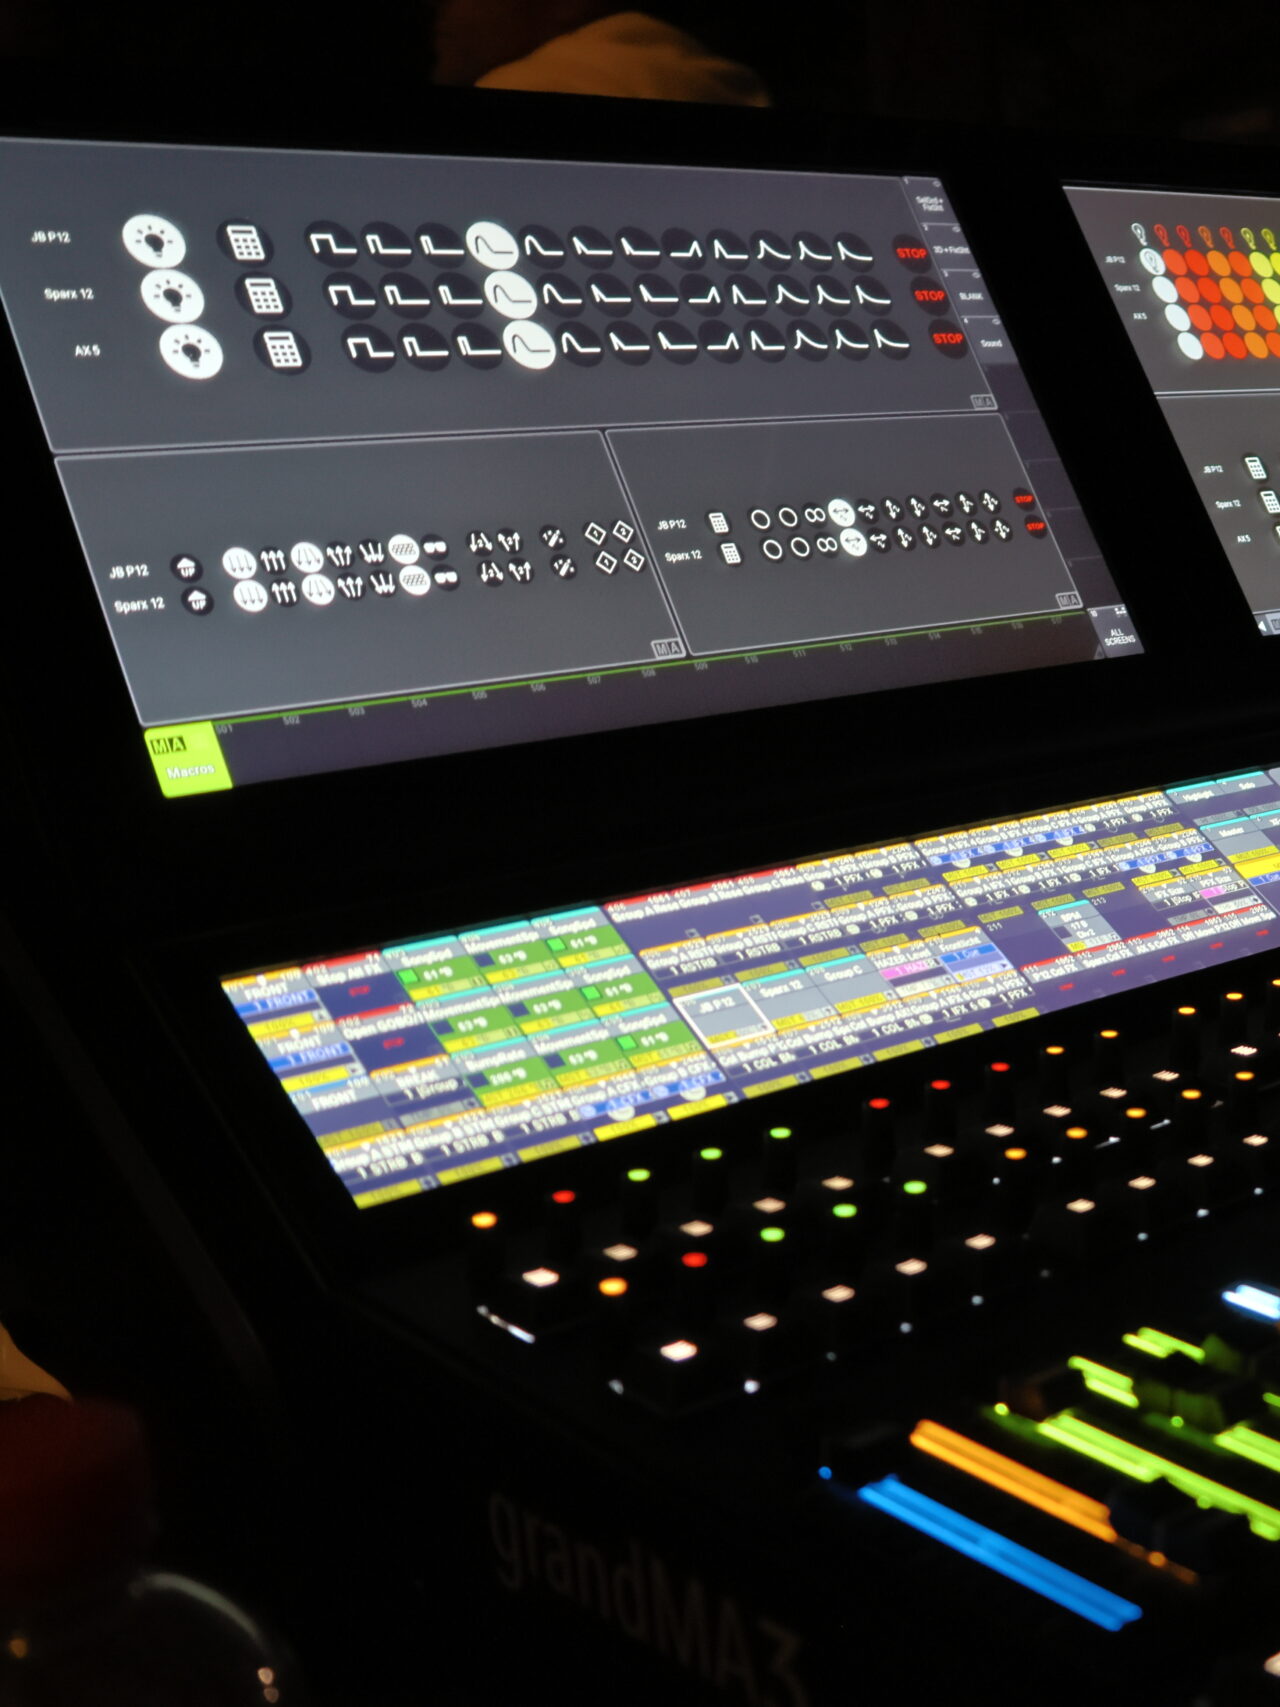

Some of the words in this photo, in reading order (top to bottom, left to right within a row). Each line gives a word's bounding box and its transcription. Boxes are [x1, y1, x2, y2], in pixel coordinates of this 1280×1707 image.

[896, 248, 928, 259] STOP
[44, 287, 78, 302] Sparx
[79, 287, 94, 300] 12
[914, 290, 945, 301] STOP
[932, 333, 963, 344] STOP
[664, 551, 690, 563] Sparx
[691, 549, 702, 560] 12
[114, 600, 148, 615] Sparx
[150, 596, 165, 609] 12
[1104, 634, 1136, 647] SCREENS
[1110, 628, 1125, 639] ALL
[282, 714, 301, 726] 502
[348, 706, 366, 717] 503
[411, 697, 428, 709] 504
[150, 736, 187, 755] MA
[166, 763, 216, 779] Macros
[1077, 814, 1101, 824] Group
[1027, 824, 1052, 834] Group
[861, 858, 891, 870] Group
[1061, 863, 1087, 873] Group
[803, 869, 833, 882] Group
[1010, 874, 1036, 885] Group
[742, 882, 773, 895] Group
[677, 894, 712, 909] Group
[897, 900, 926, 912] Group
[611, 908, 646, 923] Group
[838, 912, 868, 925] Group
[1060, 911, 1083, 921] BPM
[712, 940, 746, 954] Group
[645, 955, 680, 969] Group
[874, 954, 907, 968] HAZER
[823, 968, 855, 982] Group
[244, 983, 290, 1000] FRONT
[760, 984, 791, 998] Sparx
[787, 980, 804, 989] 12
[265, 990, 312, 1008] FRONT
[910, 1001, 941, 1015] Group
[880, 1022, 903, 1034] COL
[277, 1036, 324, 1054] FRONT
[818, 1039, 842, 1051] COL
[753, 1057, 777, 1069] COL
[311, 1090, 358, 1109] FRONT
[487, 1490, 814, 1707] grandMA3
